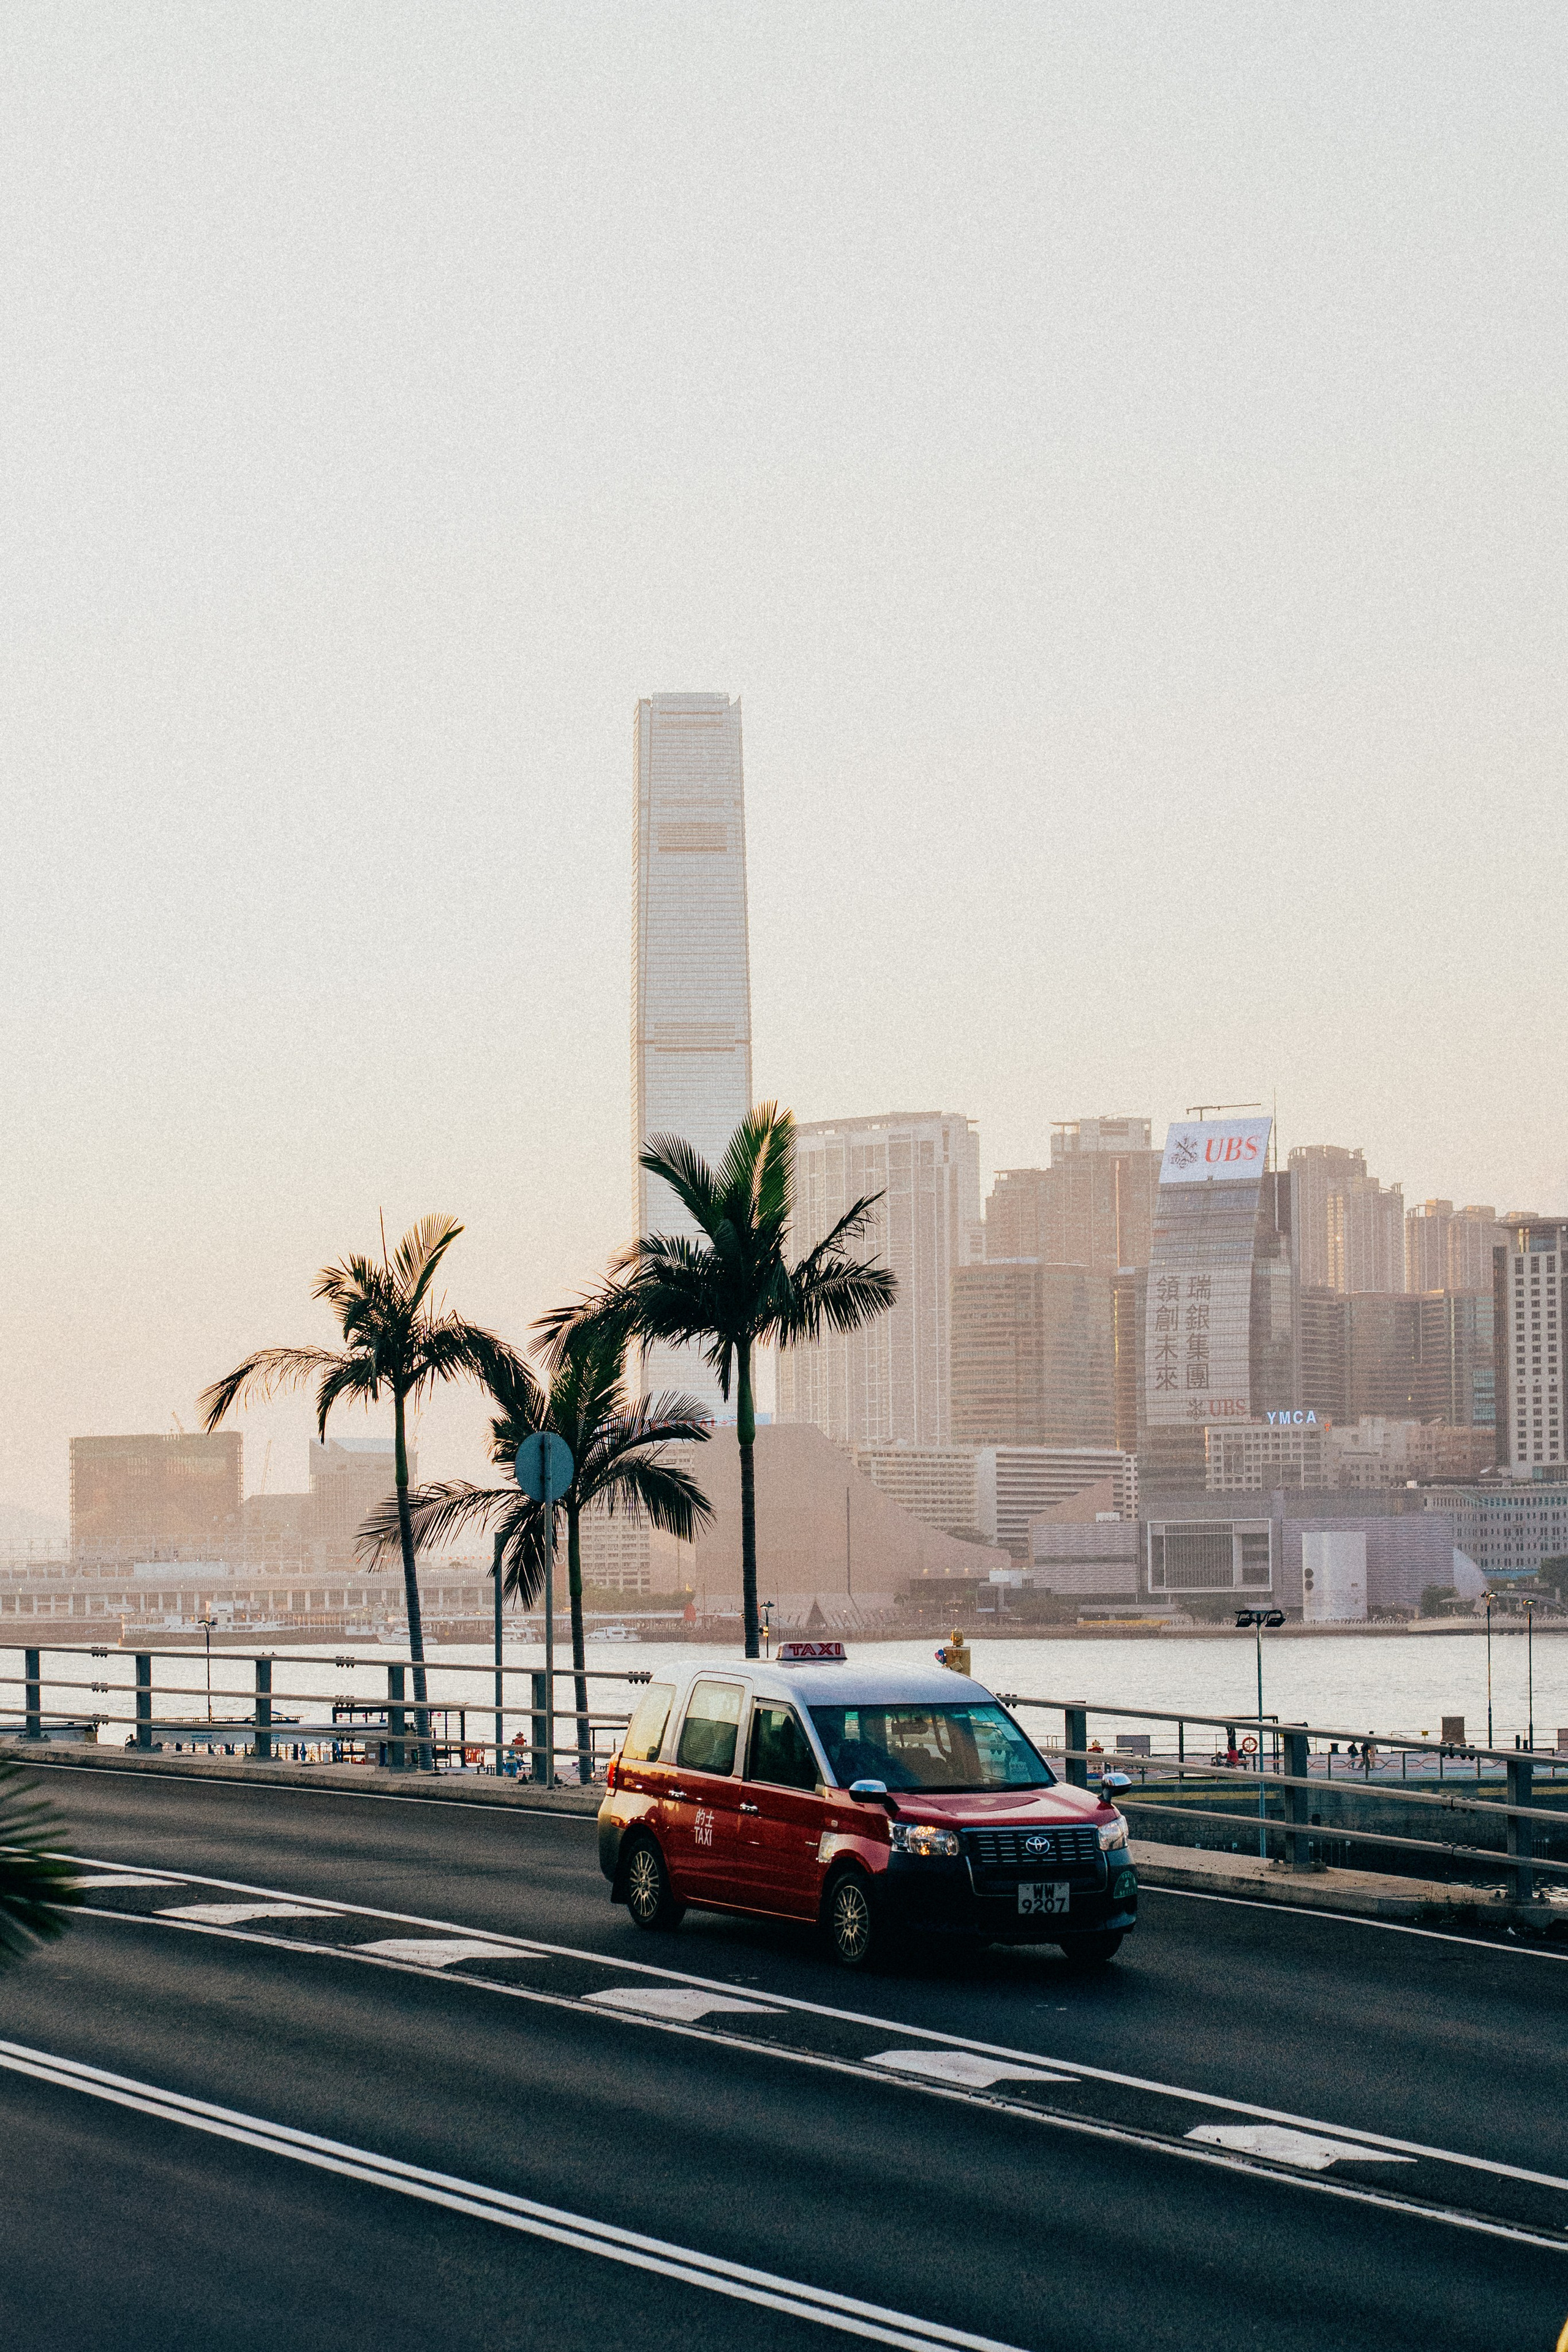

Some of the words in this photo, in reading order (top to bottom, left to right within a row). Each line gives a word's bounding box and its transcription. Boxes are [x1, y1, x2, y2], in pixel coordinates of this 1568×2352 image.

[1205, 1135, 1261, 1163] UBS
[1155, 1275, 1179, 1391] 領創未來
[1186, 1274, 1212, 1390] 瑞銀集團
[1209, 1399, 1246, 1417] UBS
[1267, 1410, 1316, 1425] YMCA
[789, 1642, 841, 1656] TAXI
[695, 1808, 715, 1828] 的士
[694, 1826, 712, 1846] TAXI
[1033, 1883, 1055, 1899] WW
[1022, 1898, 1066, 1913] 9207
